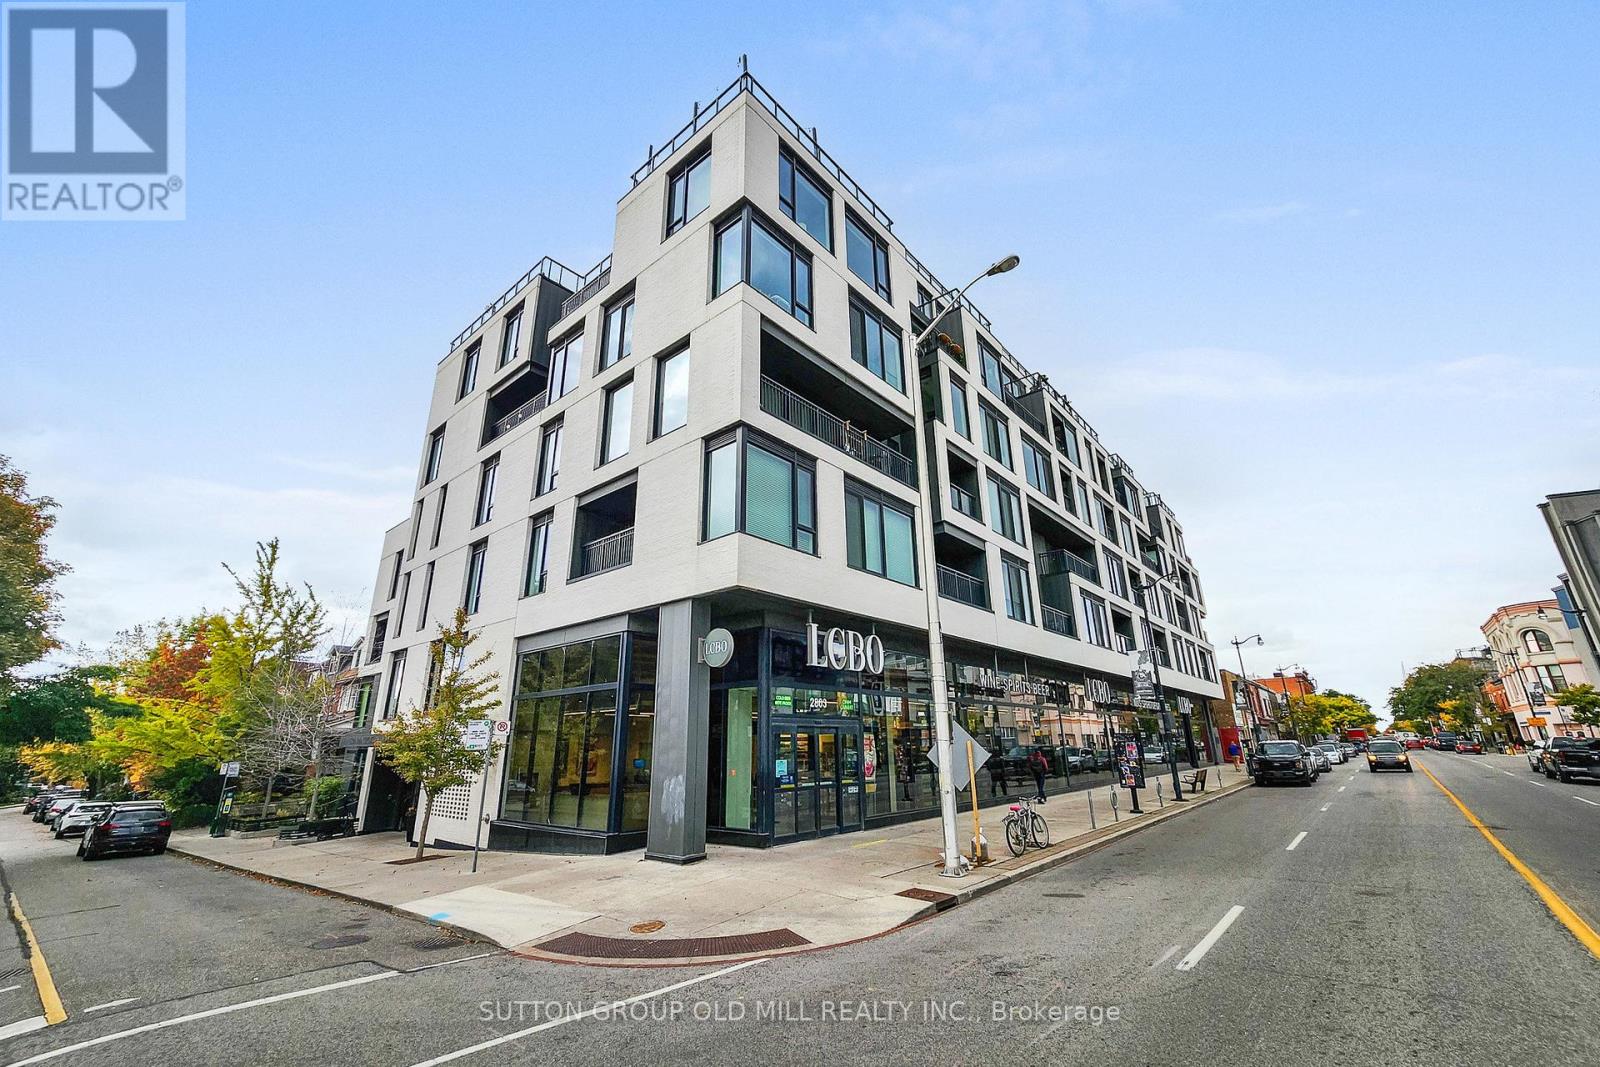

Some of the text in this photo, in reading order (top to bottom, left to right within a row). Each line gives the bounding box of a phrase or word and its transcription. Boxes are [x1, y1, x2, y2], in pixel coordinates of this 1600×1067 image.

[705, 640, 728, 655] LCBO
[805, 623, 886, 675] LCBO
[1084, 678, 1111, 704] LCBO
